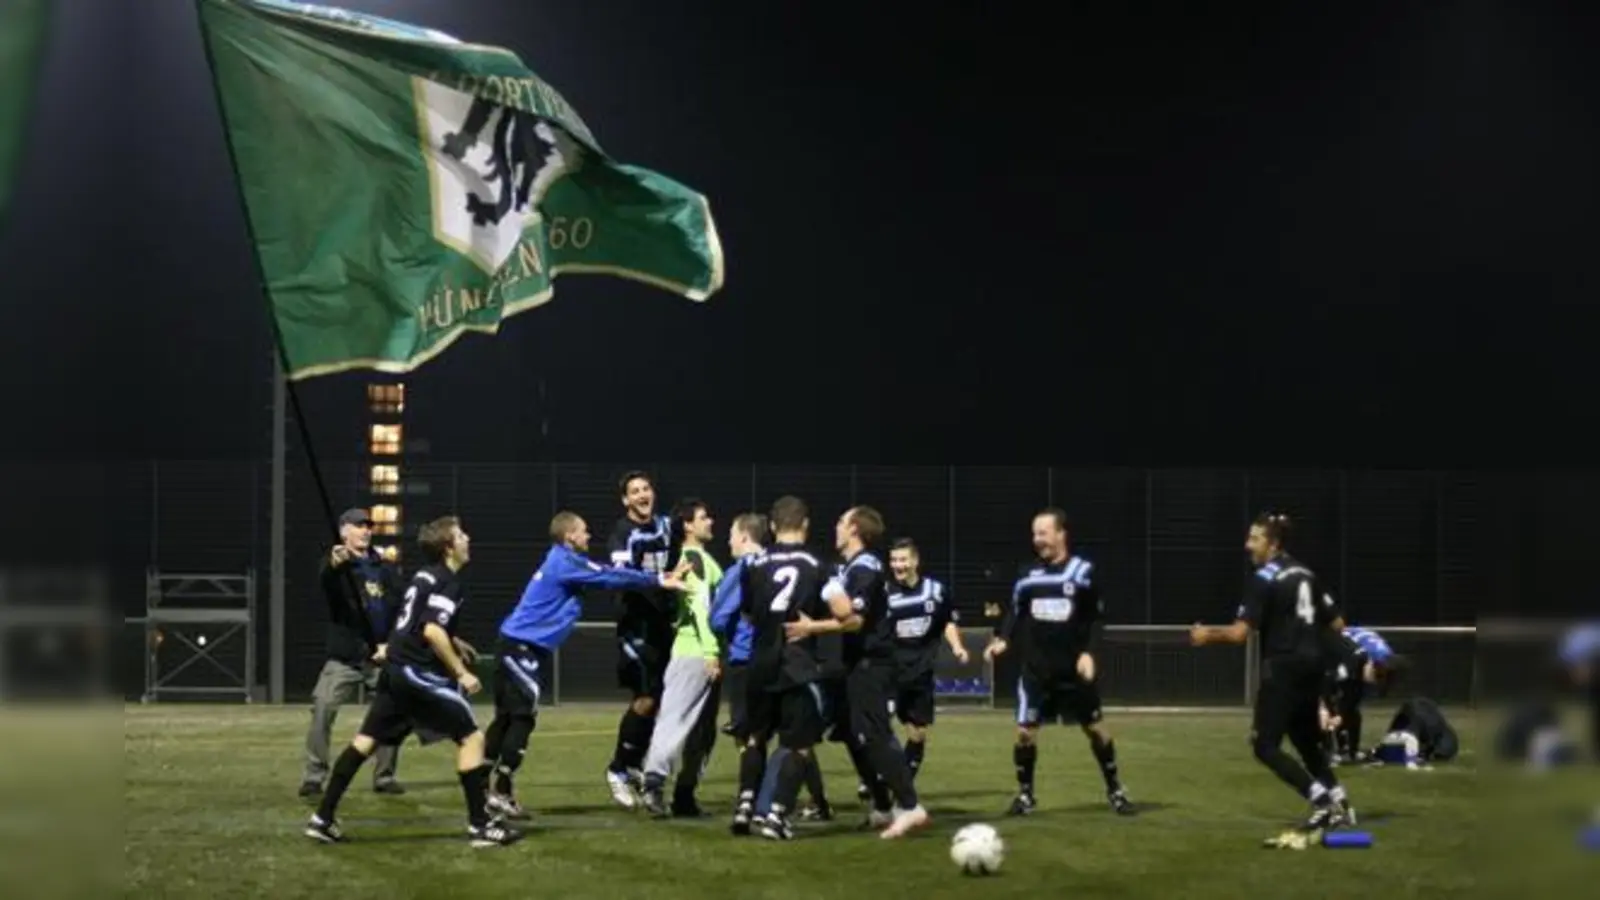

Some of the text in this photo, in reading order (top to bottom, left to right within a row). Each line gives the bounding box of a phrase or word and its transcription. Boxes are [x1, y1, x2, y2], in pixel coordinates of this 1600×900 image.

[549, 216, 592, 250] 60
[770, 565, 799, 611] 2
[1296, 580, 1315, 625] 4
